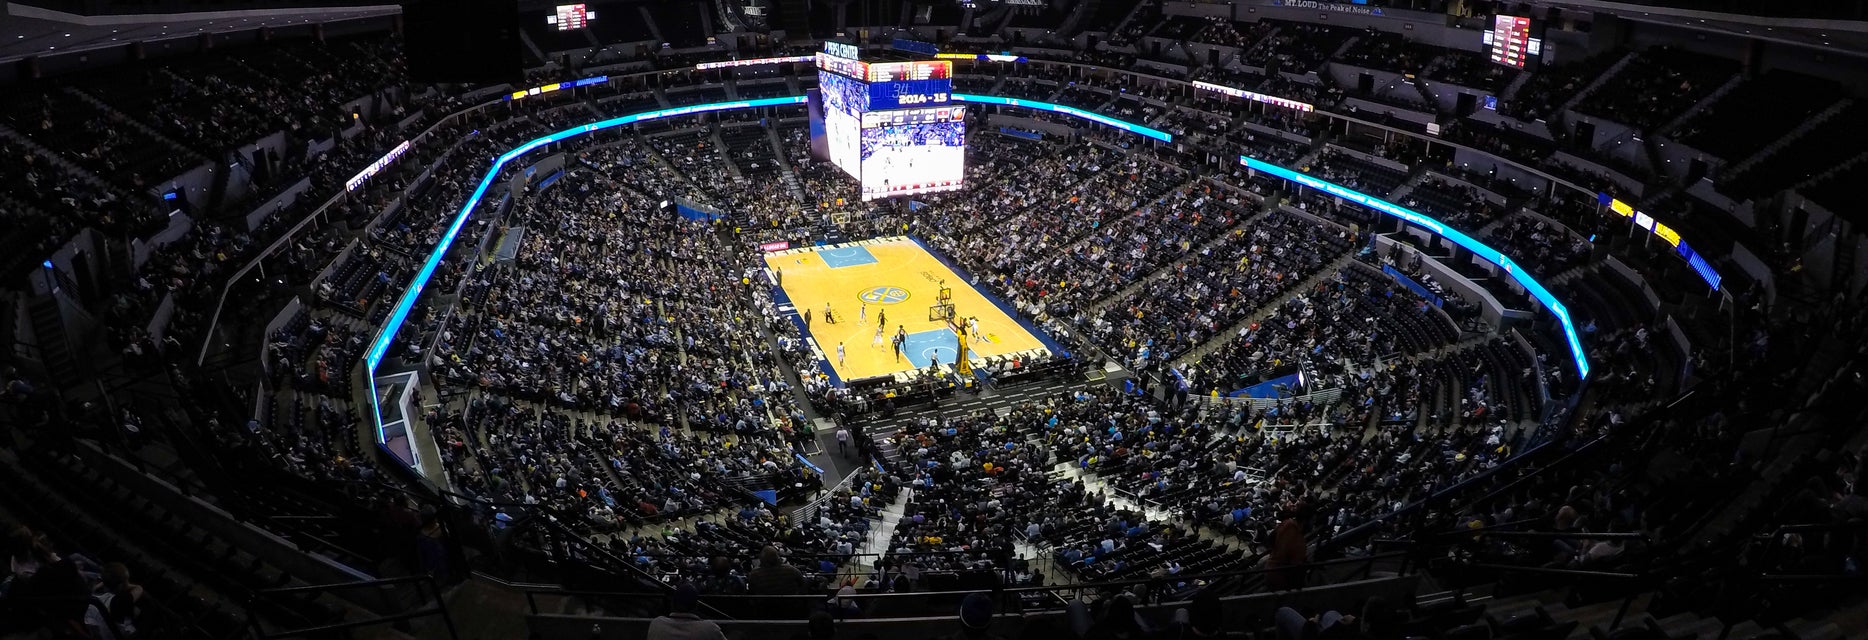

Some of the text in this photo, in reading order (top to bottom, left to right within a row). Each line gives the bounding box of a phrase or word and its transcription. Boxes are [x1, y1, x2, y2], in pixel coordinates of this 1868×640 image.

[1298, 0, 1317, 9] LOUD
[1319, 3, 1329, 11] The
[1330, 4, 1345, 12] Peak
[1345, 5, 1352, 13] of
[1352, 6, 1370, 15] Noise
[828, 41, 859, 60] PEPSI CENTER
[891, 82, 909, 98] 34
[899, 94, 927, 105] 2014
[933, 92, 948, 103] 15
